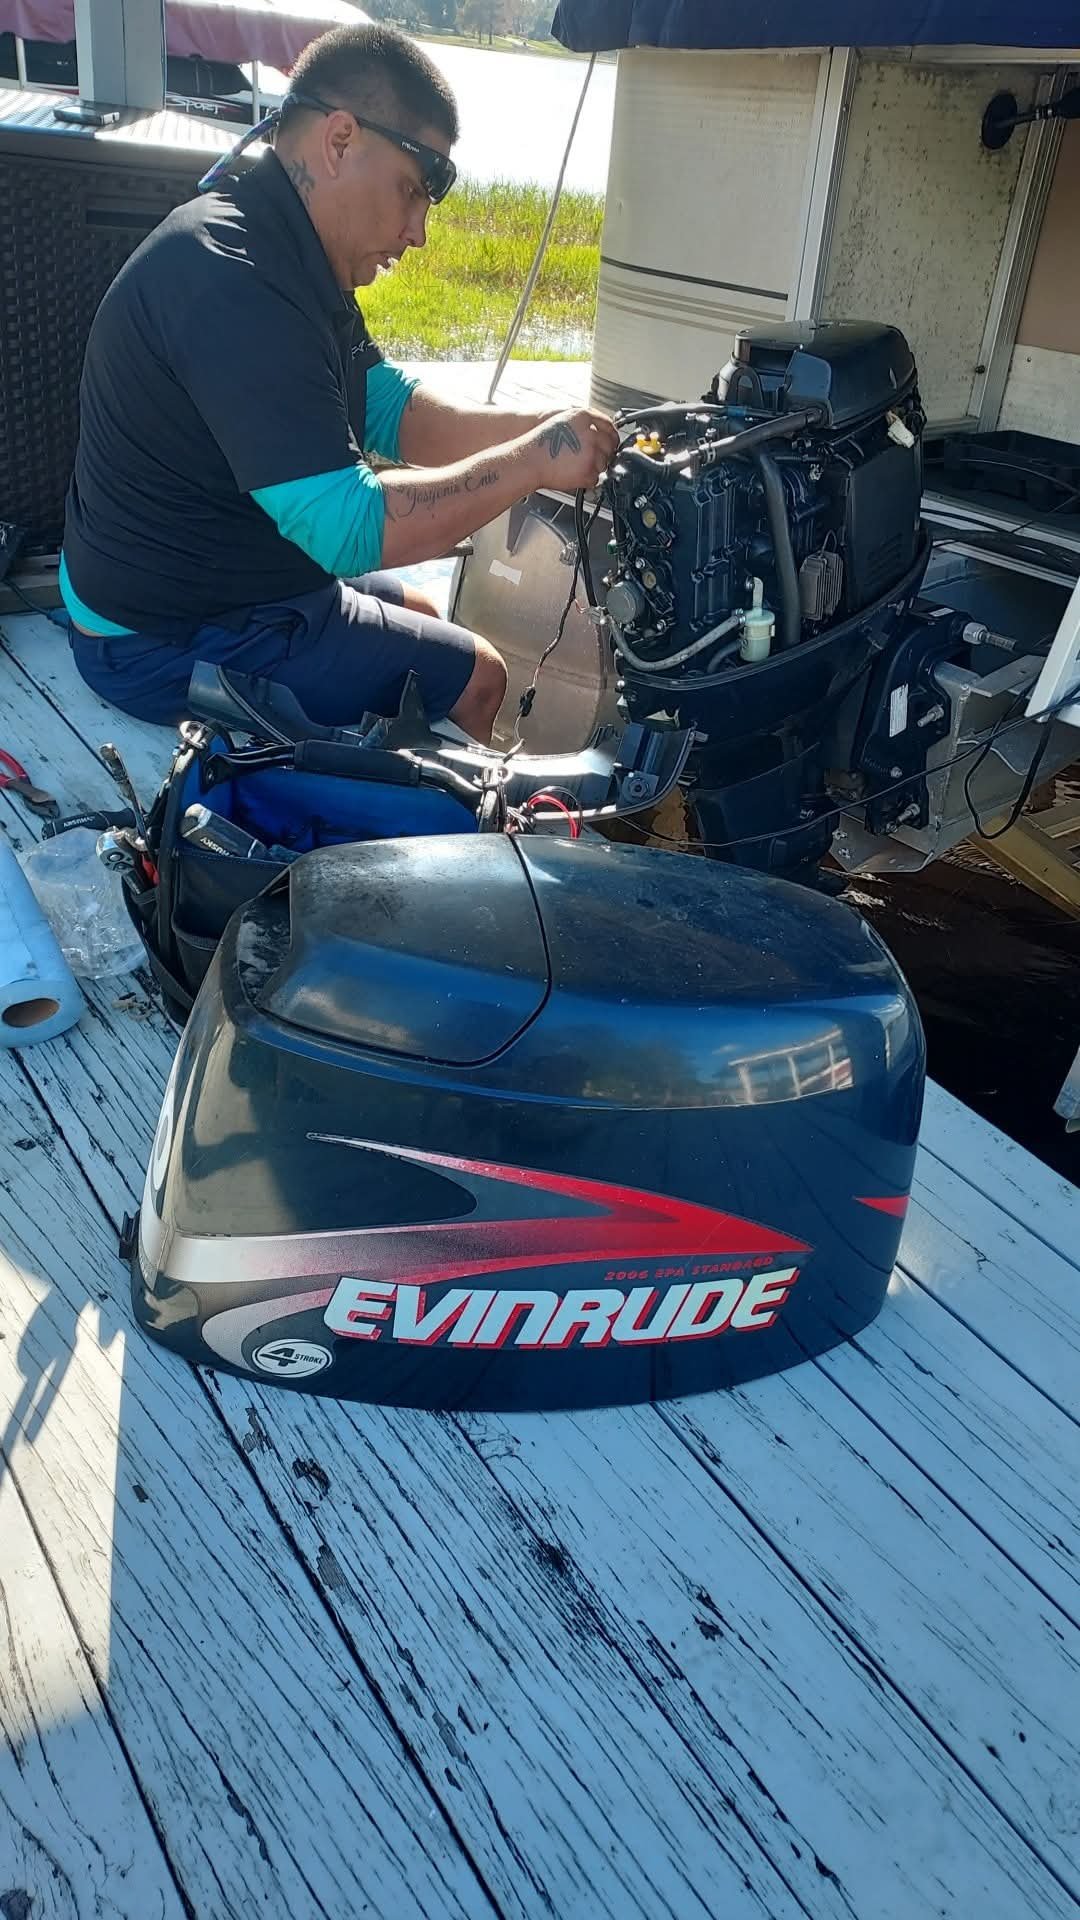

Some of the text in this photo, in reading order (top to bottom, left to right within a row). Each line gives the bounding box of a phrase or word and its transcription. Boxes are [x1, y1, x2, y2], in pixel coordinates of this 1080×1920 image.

[604, 1255, 775, 1281] 2006 EPA STANDARD
[323, 1265, 801, 1350] EVINRUDE
[259, 1347, 325, 1367] 4 STROKE
